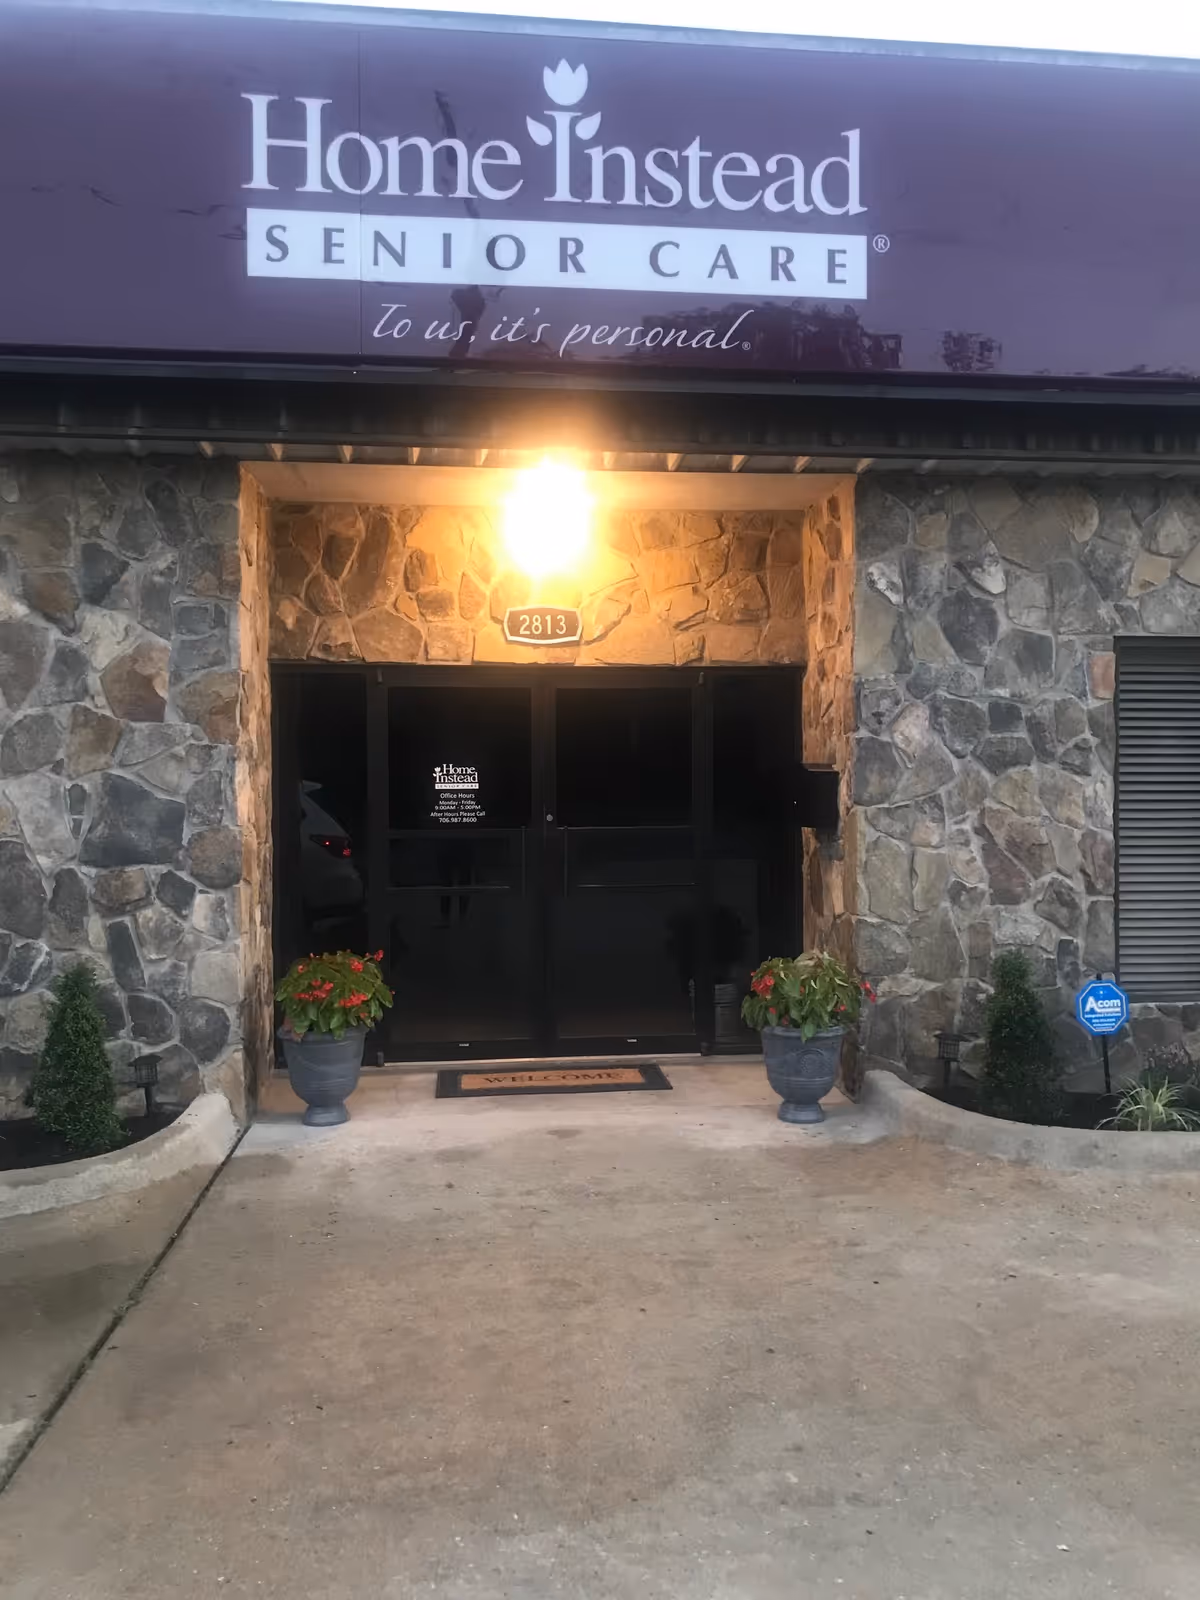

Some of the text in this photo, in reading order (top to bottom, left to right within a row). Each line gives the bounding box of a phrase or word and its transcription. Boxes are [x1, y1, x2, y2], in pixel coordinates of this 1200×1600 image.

[241, 92, 868, 216] Home Instead
[264, 224, 848, 285] SENIOR CARE
[372, 303, 412, 339] To
[424, 319, 475, 344] us,
[490, 306, 551, 344] it's
[518, 614, 567, 636] 2813
[436, 772, 478, 783] Instead
[443, 764, 476, 774] Home
[1084, 996, 1121, 1012] Acom
[484, 1071, 625, 1085] WELCOME
